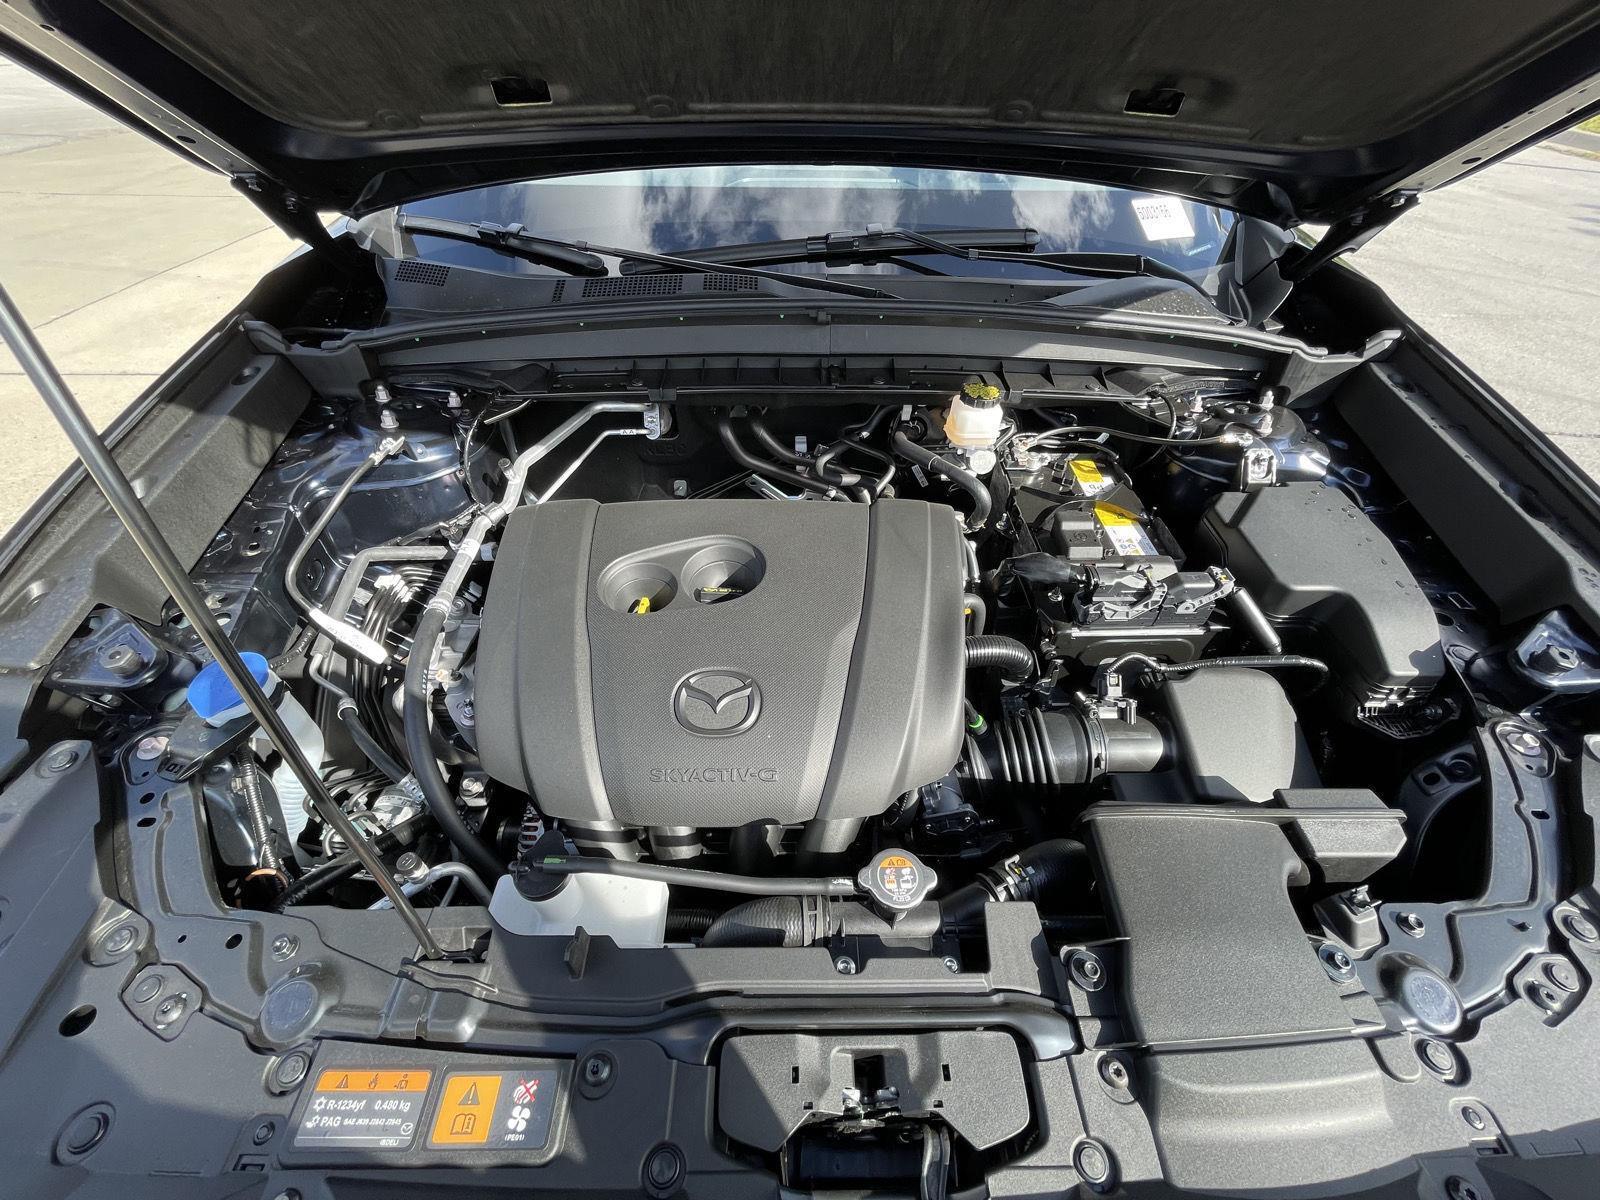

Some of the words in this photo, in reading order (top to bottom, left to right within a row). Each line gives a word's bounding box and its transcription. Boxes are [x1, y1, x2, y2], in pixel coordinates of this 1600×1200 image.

[649, 767, 778, 783] SKYACTIV-G
[326, 1100, 367, 1112] R-1234yf
[374, 1100, 398, 1110] 0.480
[398, 1100, 411, 1112] kg
[320, 1116, 342, 1127] PAG
